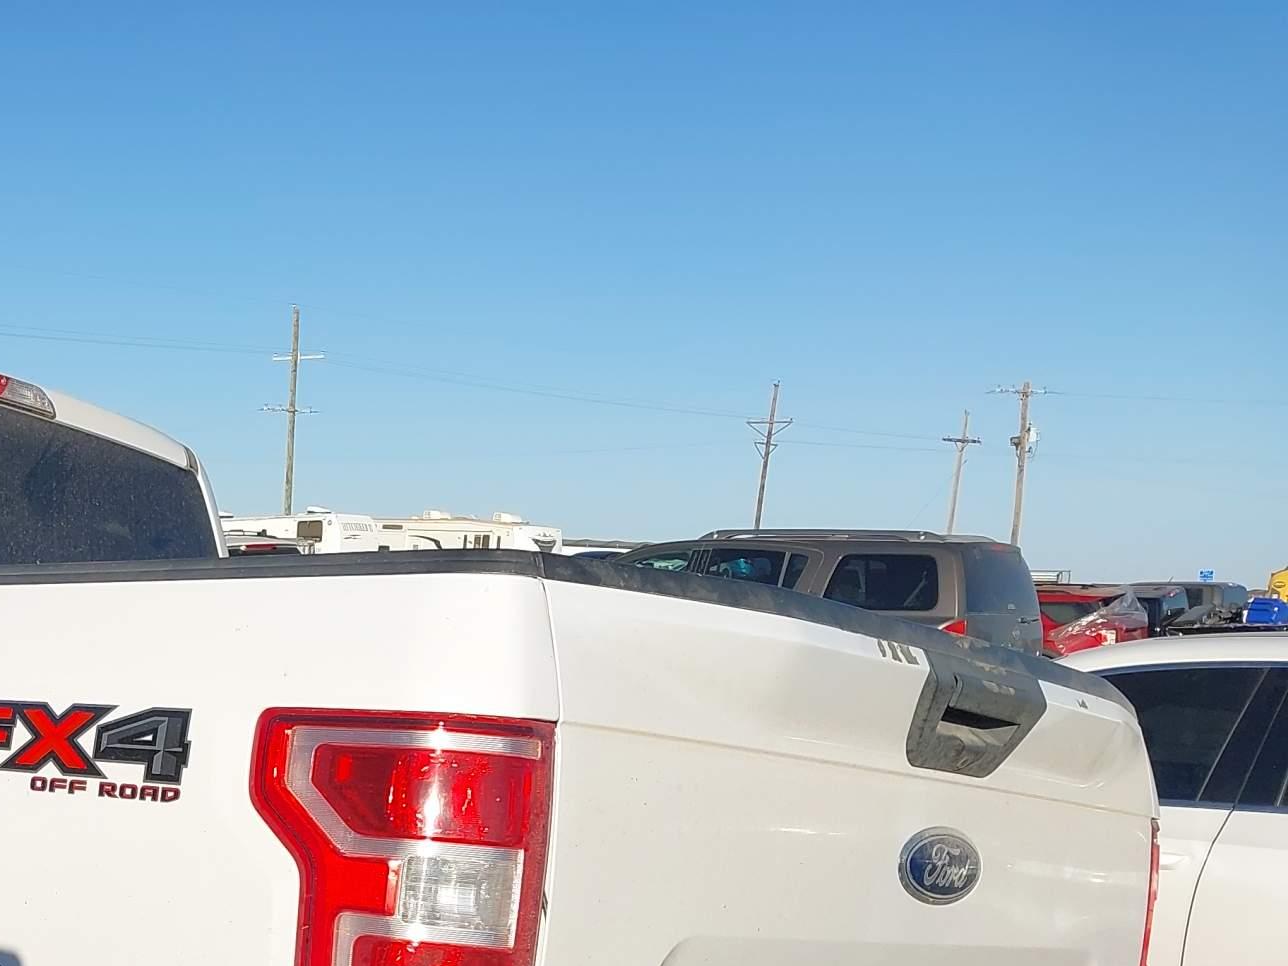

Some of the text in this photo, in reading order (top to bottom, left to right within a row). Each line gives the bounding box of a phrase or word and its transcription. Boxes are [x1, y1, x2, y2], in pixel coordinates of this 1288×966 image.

[29, 775, 182, 803] OFF ROAD
[923, 843, 970, 888] Ford
